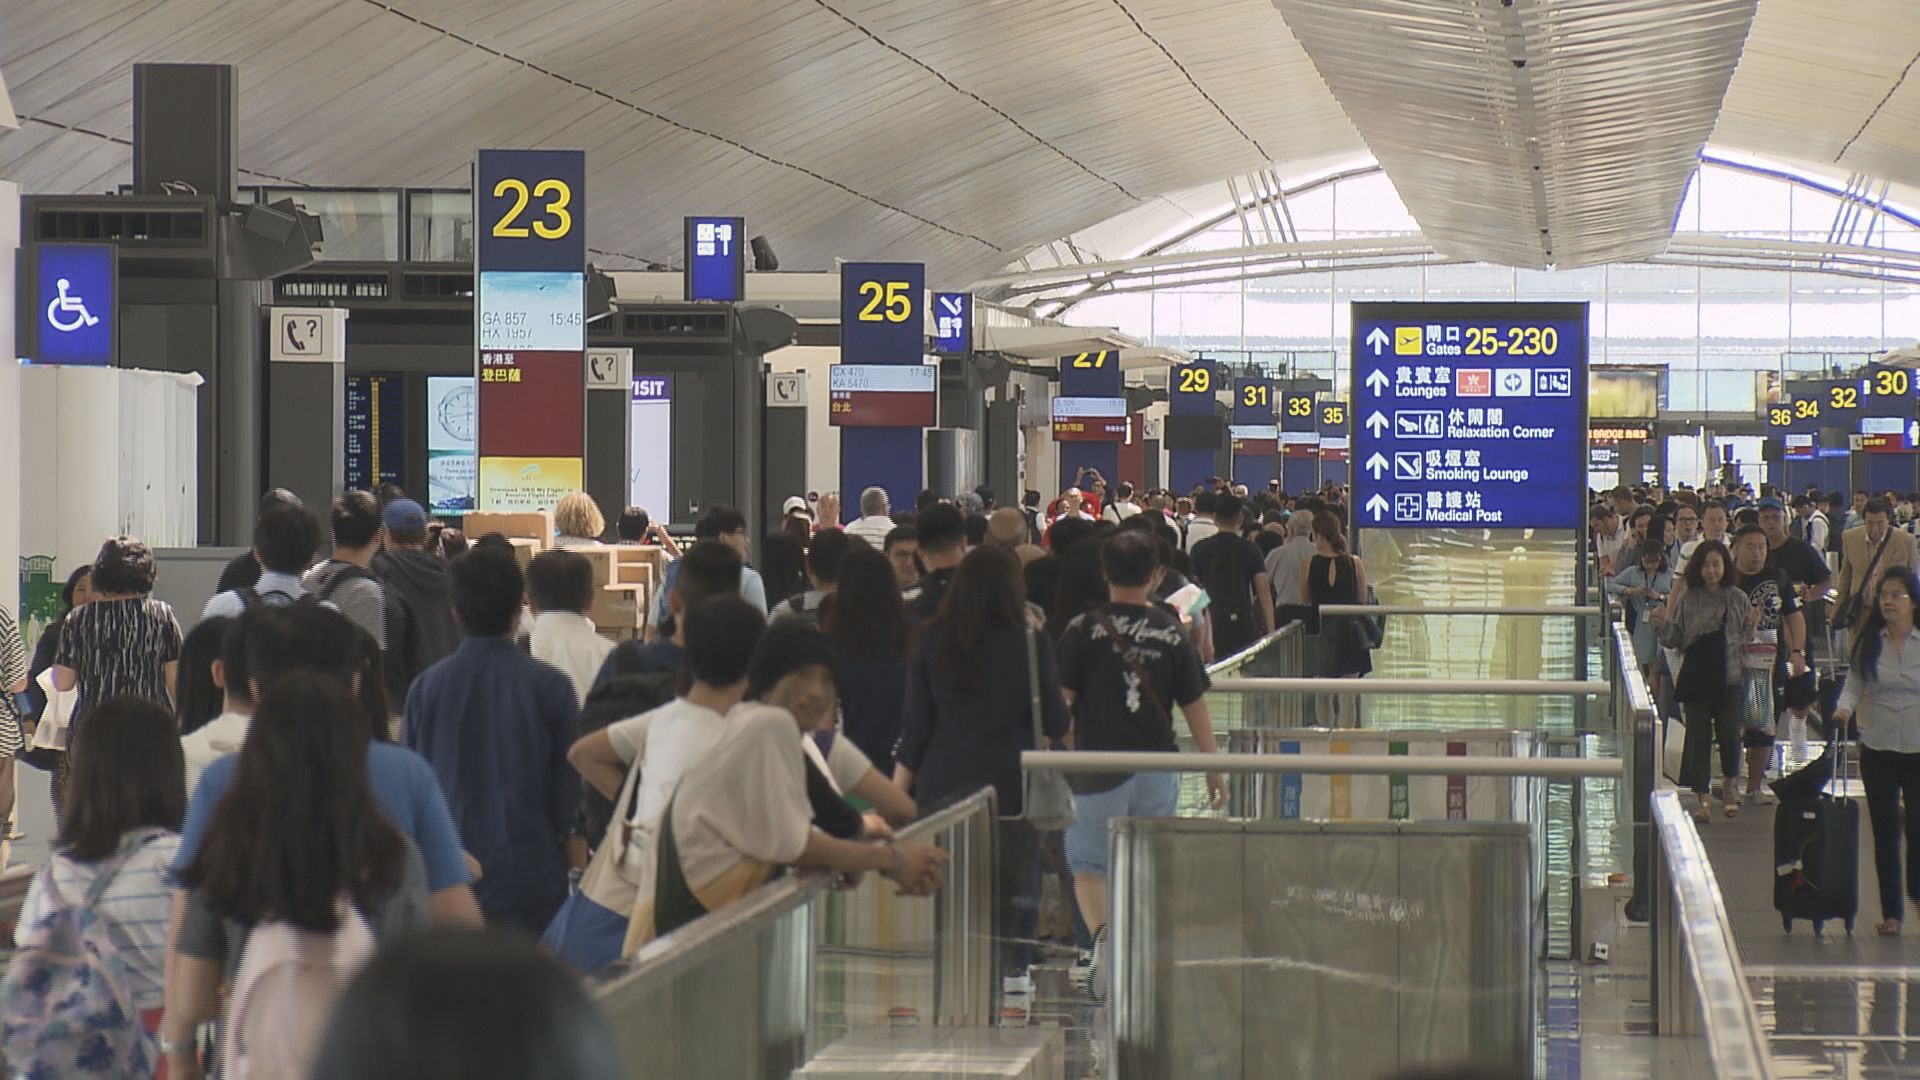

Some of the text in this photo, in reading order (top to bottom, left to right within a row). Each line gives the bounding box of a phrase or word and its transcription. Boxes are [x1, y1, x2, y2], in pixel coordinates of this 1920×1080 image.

[492, 179, 572, 239] 23
[859, 281, 911, 322] 25
[482, 311, 527, 326] GA 857
[549, 312, 582, 326] 15:45
[1426, 325, 1460, 342] 閘口
[1465, 327, 1558, 355] 25-230
[1427, 343, 1461, 356] Gates
[832, 367, 864, 377] CX 470
[1179, 368, 1210, 392] 29
[1396, 366, 1451, 384] 貴賓室
[632, 380, 665, 396] ISIT
[832, 379, 868, 388] KA 5470
[1875, 370, 1908, 395] 30
[1243, 385, 1267, 406] 31
[1396, 386, 1447, 399] Lounges
[1830, 387, 1857, 408] 32
[832, 402, 852, 412] 台北
[1288, 398, 1311, 416] 33
[1323, 407, 1343, 424] 35
[1795, 400, 1819, 419] 34
[1770, 409, 1792, 426] 36
[1448, 426, 1554, 439] Relaxation Corner
[1426, 450, 1481, 467] 吸煙室
[1426, 467, 1528, 482] Smoking Lounge
[1426, 491, 1481, 509] 醫護站
[1426, 509, 1502, 522] Medical Post
